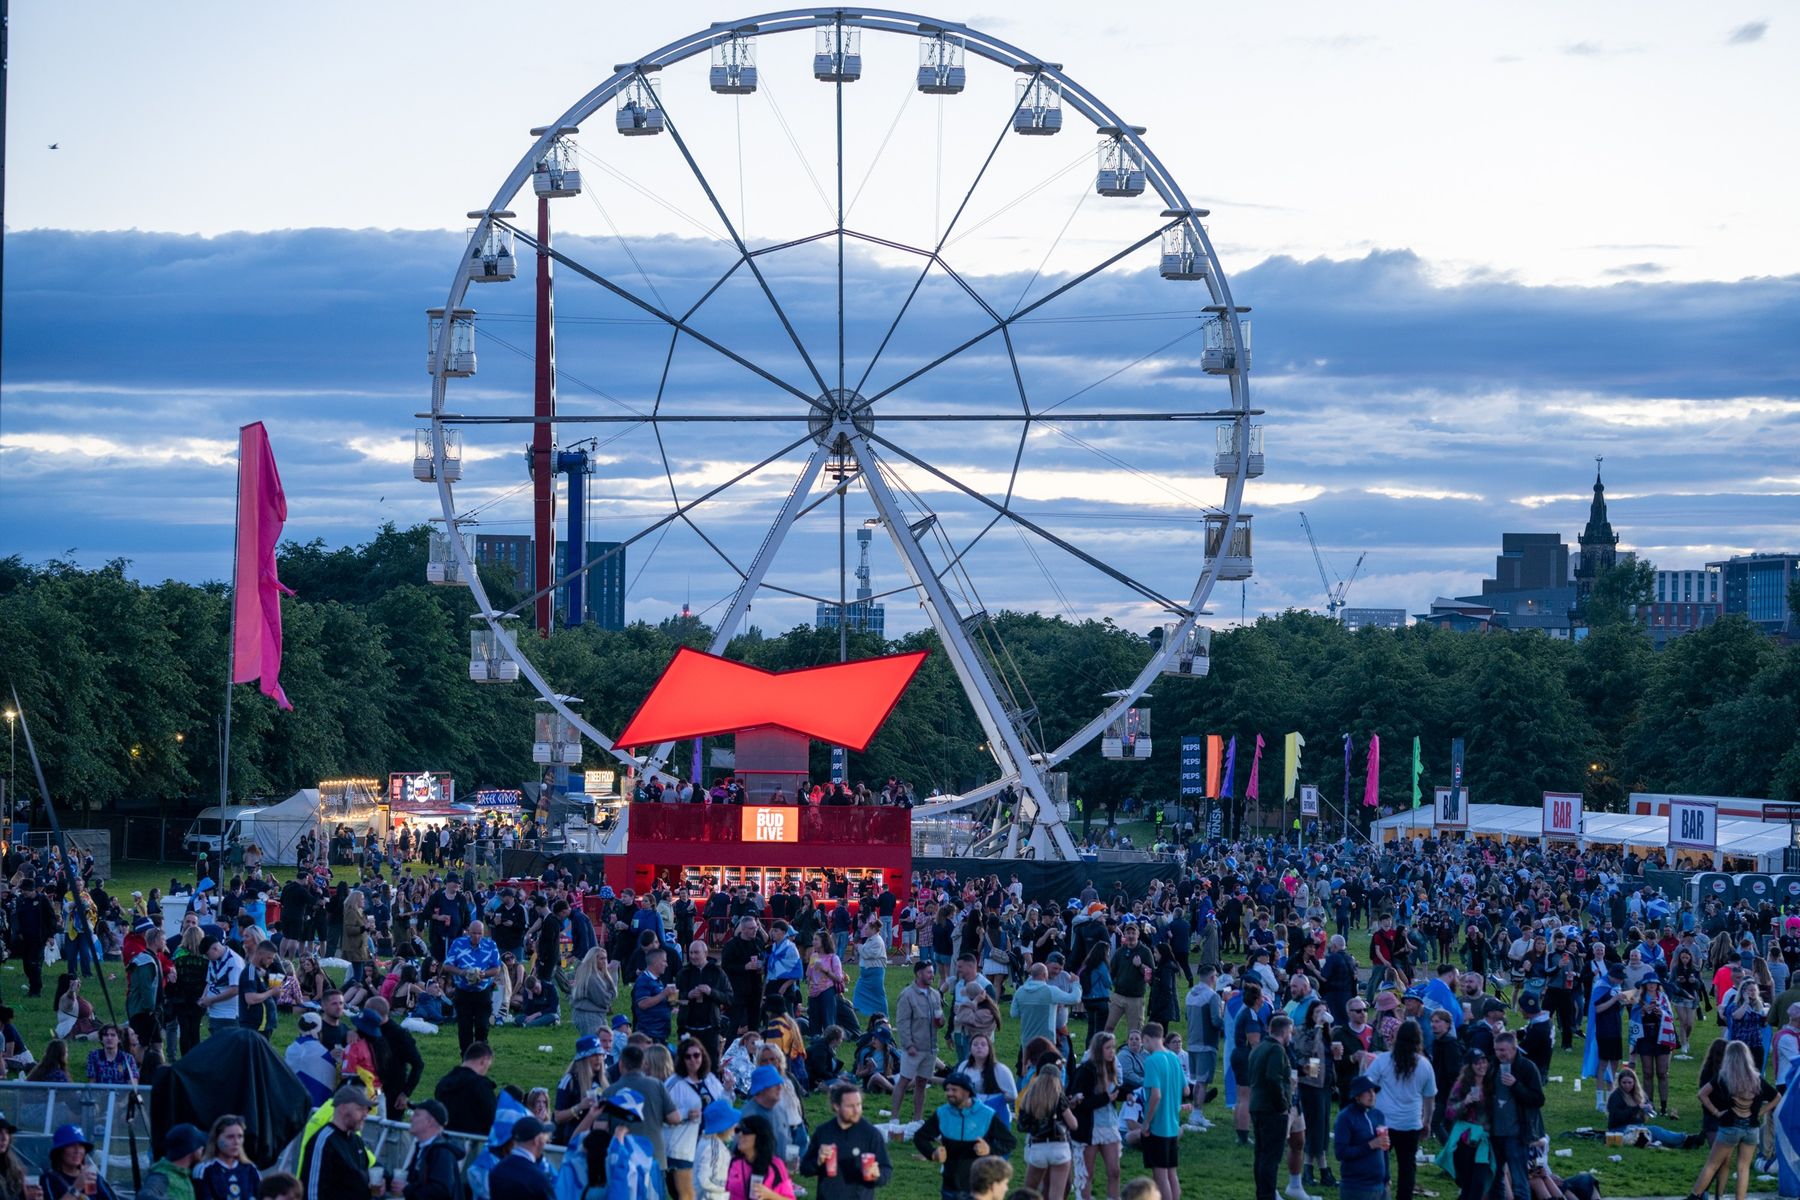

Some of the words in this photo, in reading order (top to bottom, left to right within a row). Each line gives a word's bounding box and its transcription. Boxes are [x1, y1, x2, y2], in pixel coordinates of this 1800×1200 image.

[585, 771, 602, 783] STREET
[602, 771, 614, 783] FOOD
[1182, 772, 1200, 780] PEPS
[497, 792, 517, 803] GYROS
[757, 813, 784, 827] BUD
[1553, 800, 1572, 829] BAR
[1578, 820, 1584, 834] 1
[1681, 808, 1704, 840] BAR
[756, 826, 784, 840] LIVE
